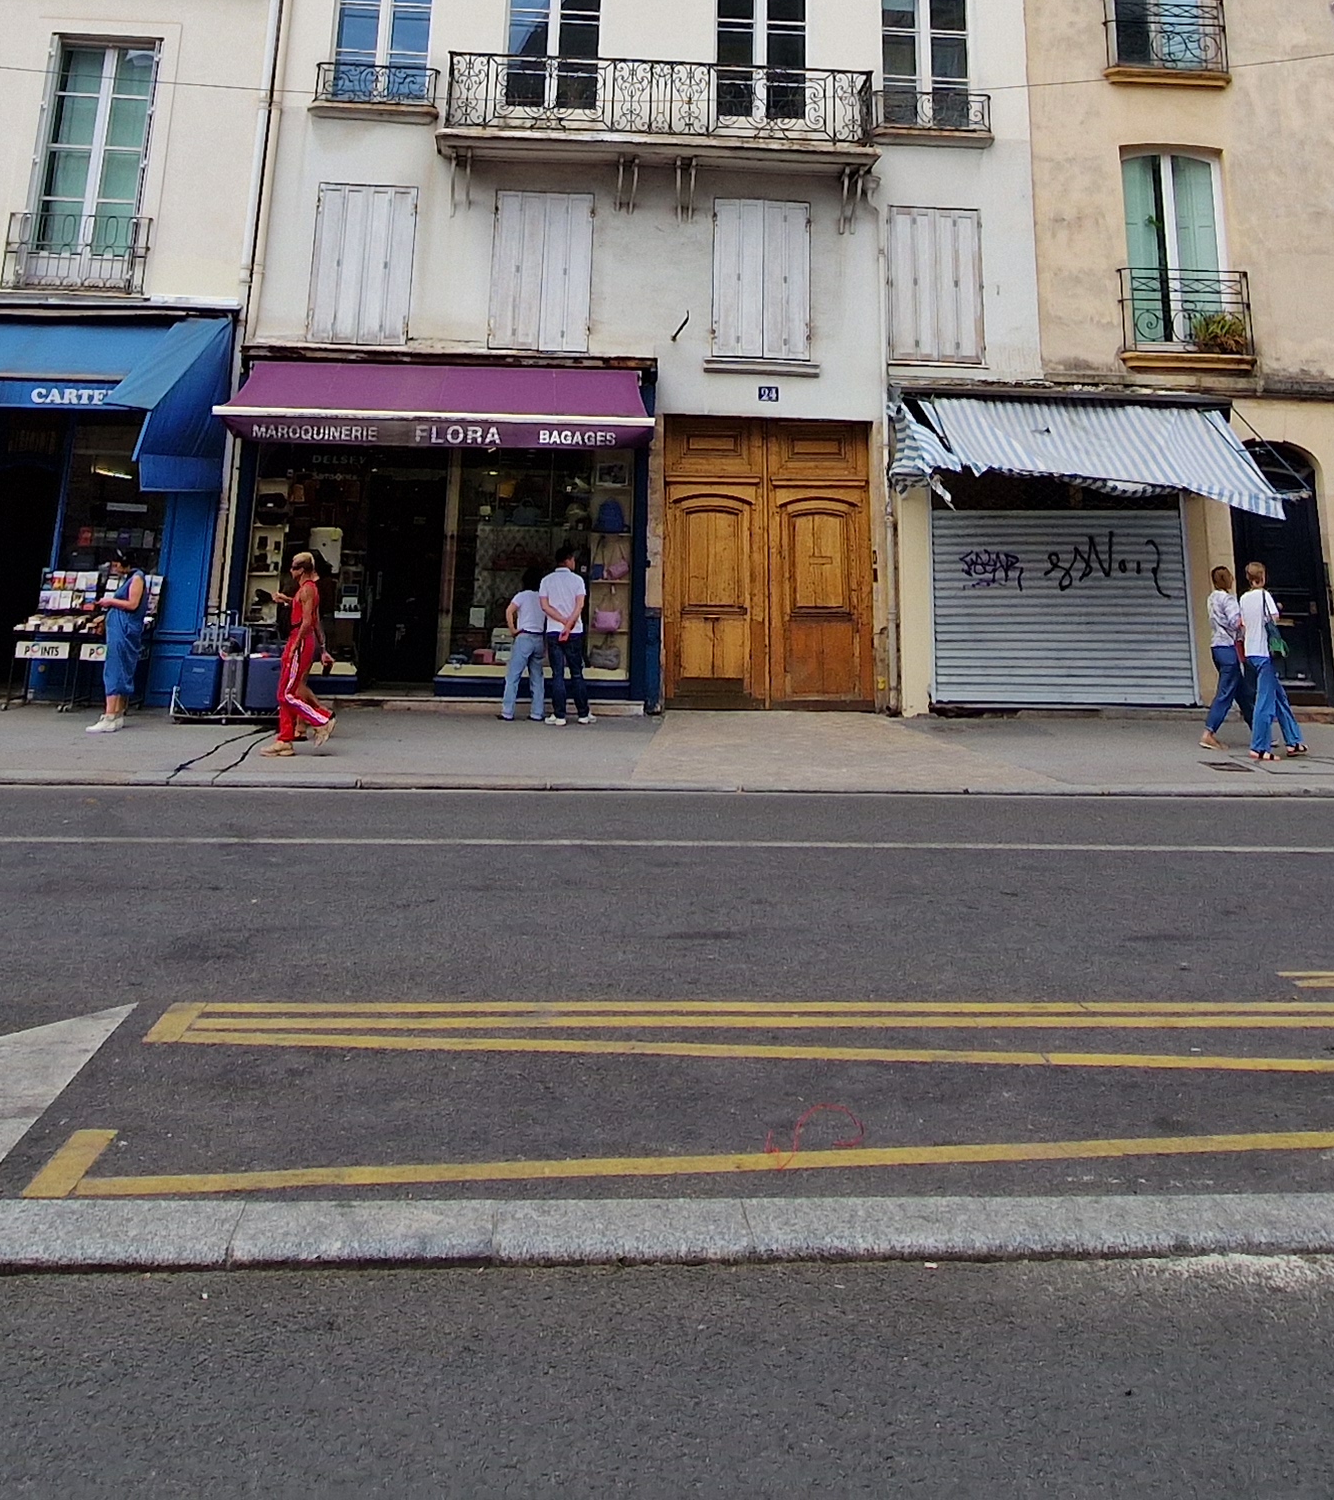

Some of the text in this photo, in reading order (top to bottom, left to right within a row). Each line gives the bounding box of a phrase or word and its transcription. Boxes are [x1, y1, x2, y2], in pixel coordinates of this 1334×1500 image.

[760, 387, 777, 401] 24
[252, 424, 616, 447] MAROQUINERIE FLORA BAGAGES
